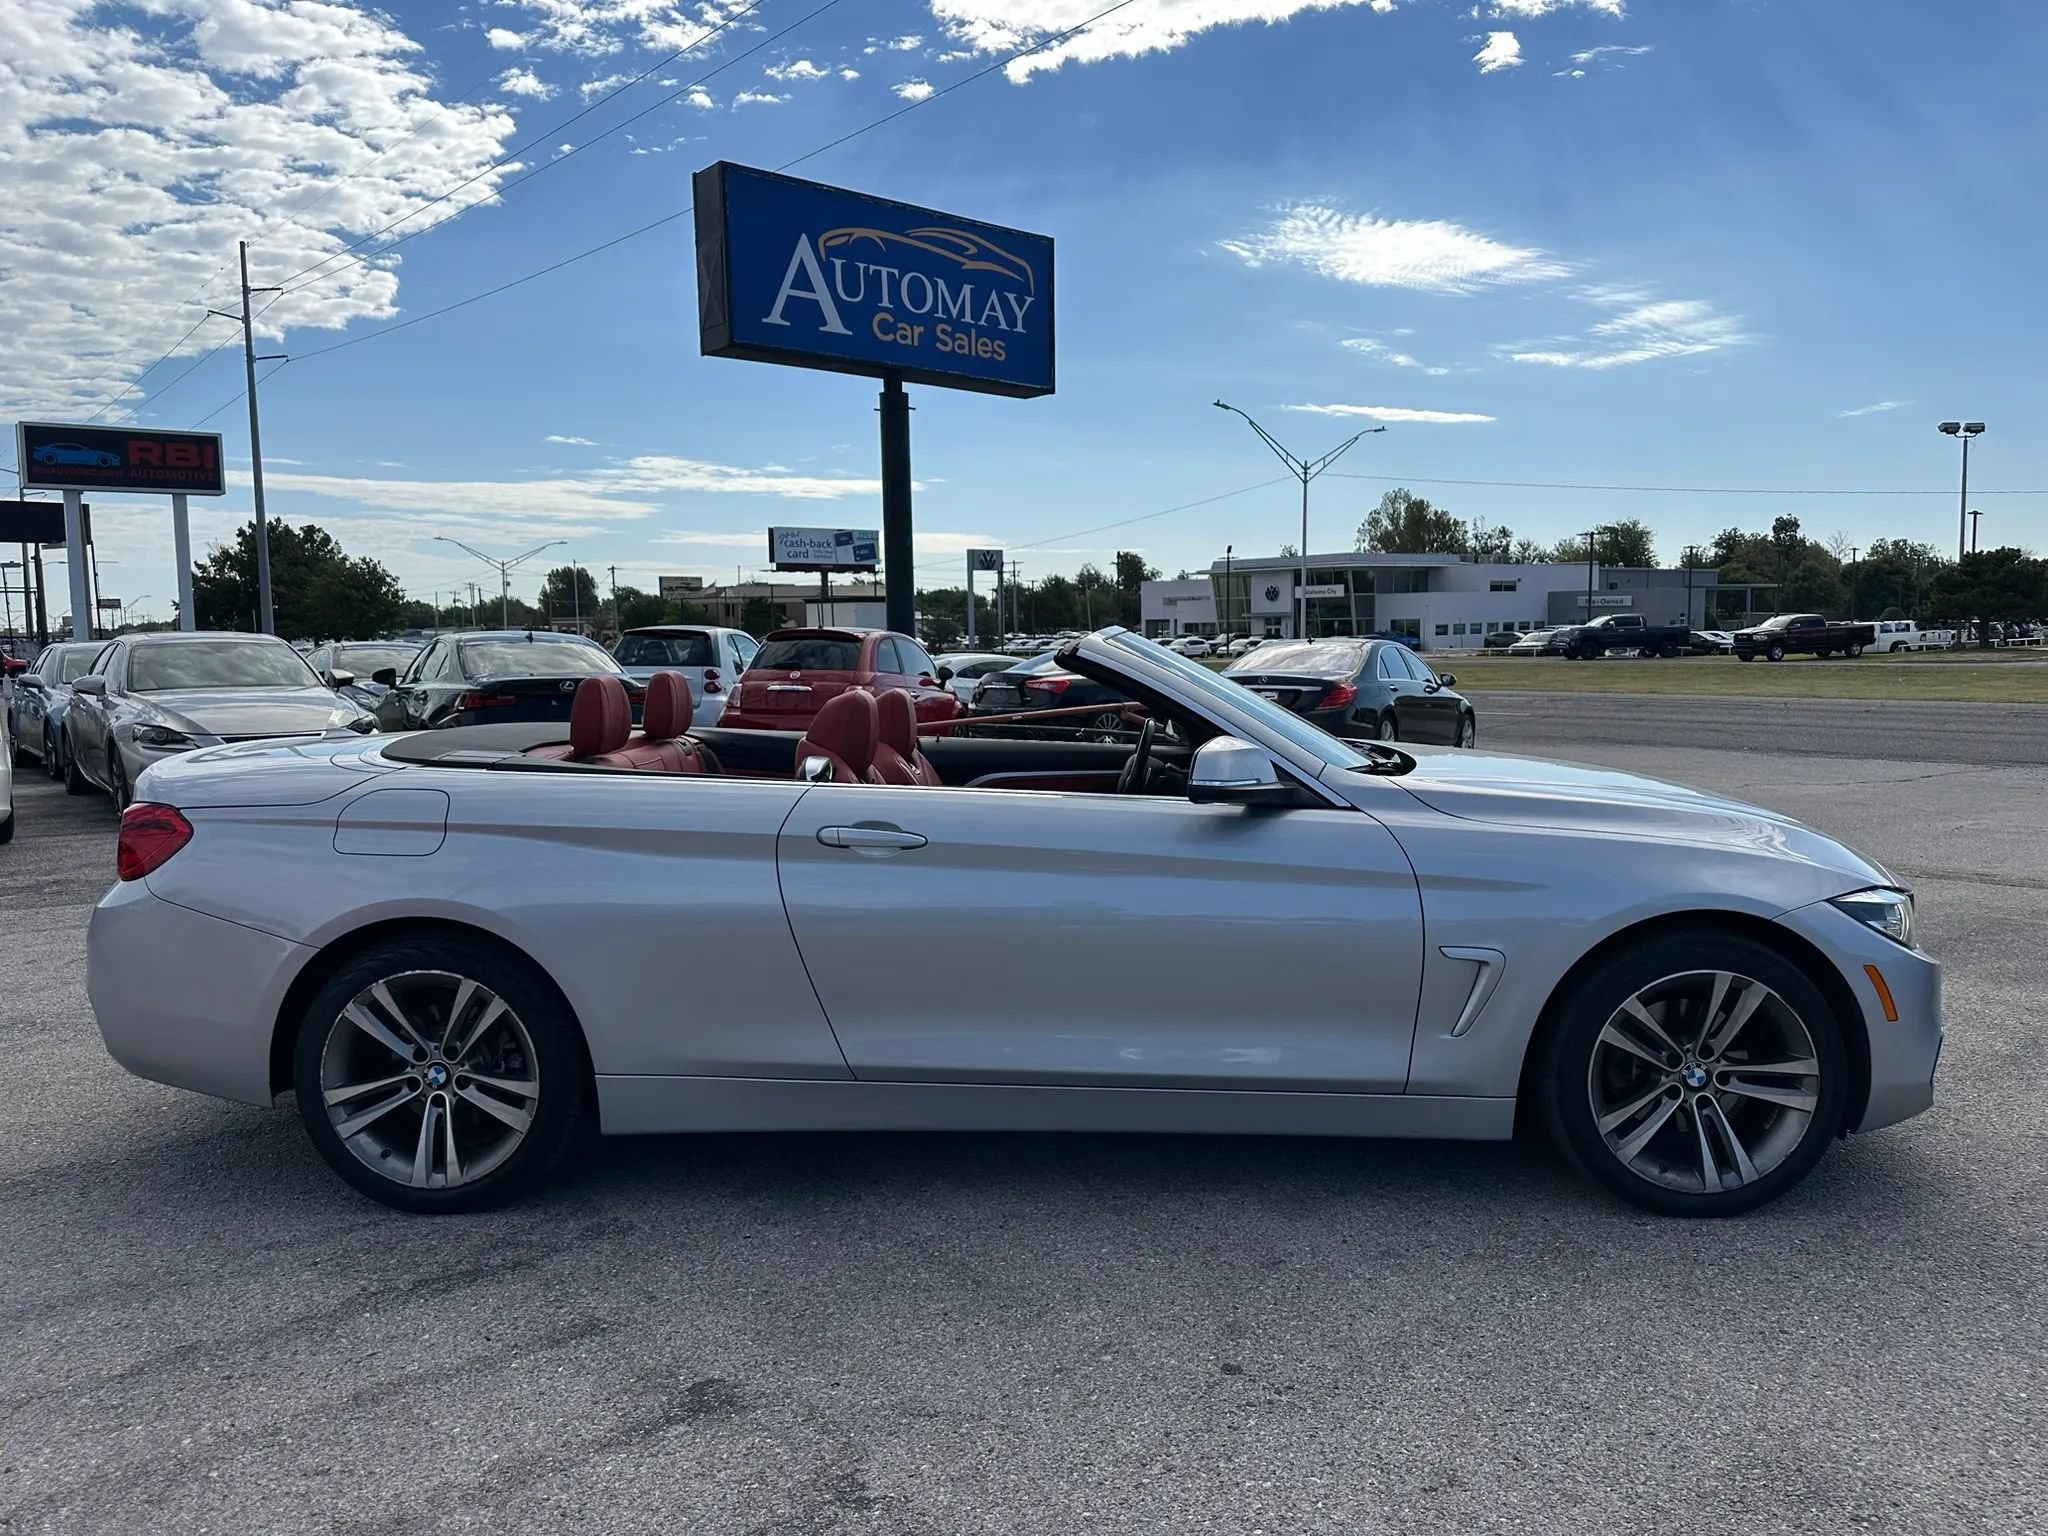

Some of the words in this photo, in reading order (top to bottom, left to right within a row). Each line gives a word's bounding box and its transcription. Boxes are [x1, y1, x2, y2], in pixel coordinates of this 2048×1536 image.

[761, 232, 1036, 336] AUTOMAY
[872, 312, 924, 347] Car
[935, 323, 1007, 362] Sales
[128, 440, 214, 468] RBI
[130, 468, 215, 482] AUTOMOTIVE
[784, 538, 832, 549] cash-back
[787, 549, 809, 559] card
